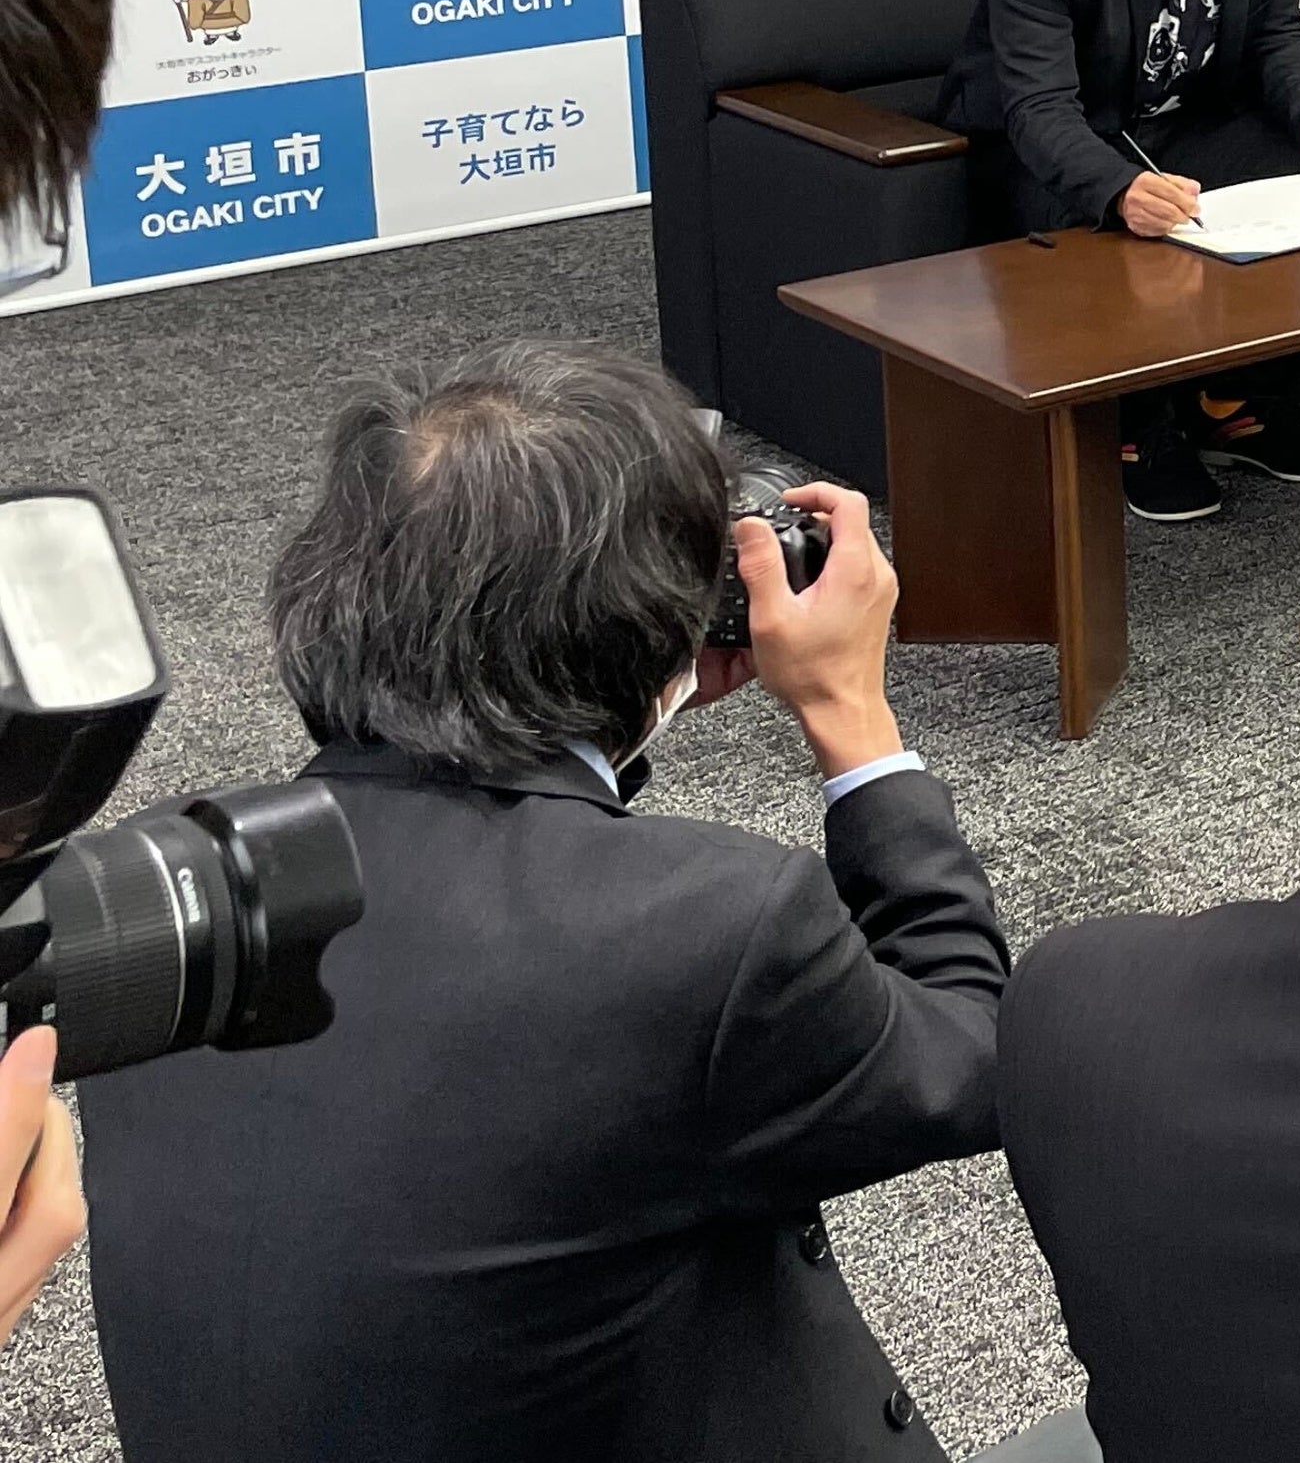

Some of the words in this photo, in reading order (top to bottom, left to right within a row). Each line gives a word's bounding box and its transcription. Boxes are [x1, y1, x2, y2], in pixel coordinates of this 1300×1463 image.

[186, 64, 257, 84] おがっきい
[422, 99, 585, 149] 子育てなら
[135, 132, 321, 201] 大垣市
[459, 143, 556, 185] 大垣市
[141, 200, 244, 238] OGAKI
[252, 186, 324, 219] CITY
